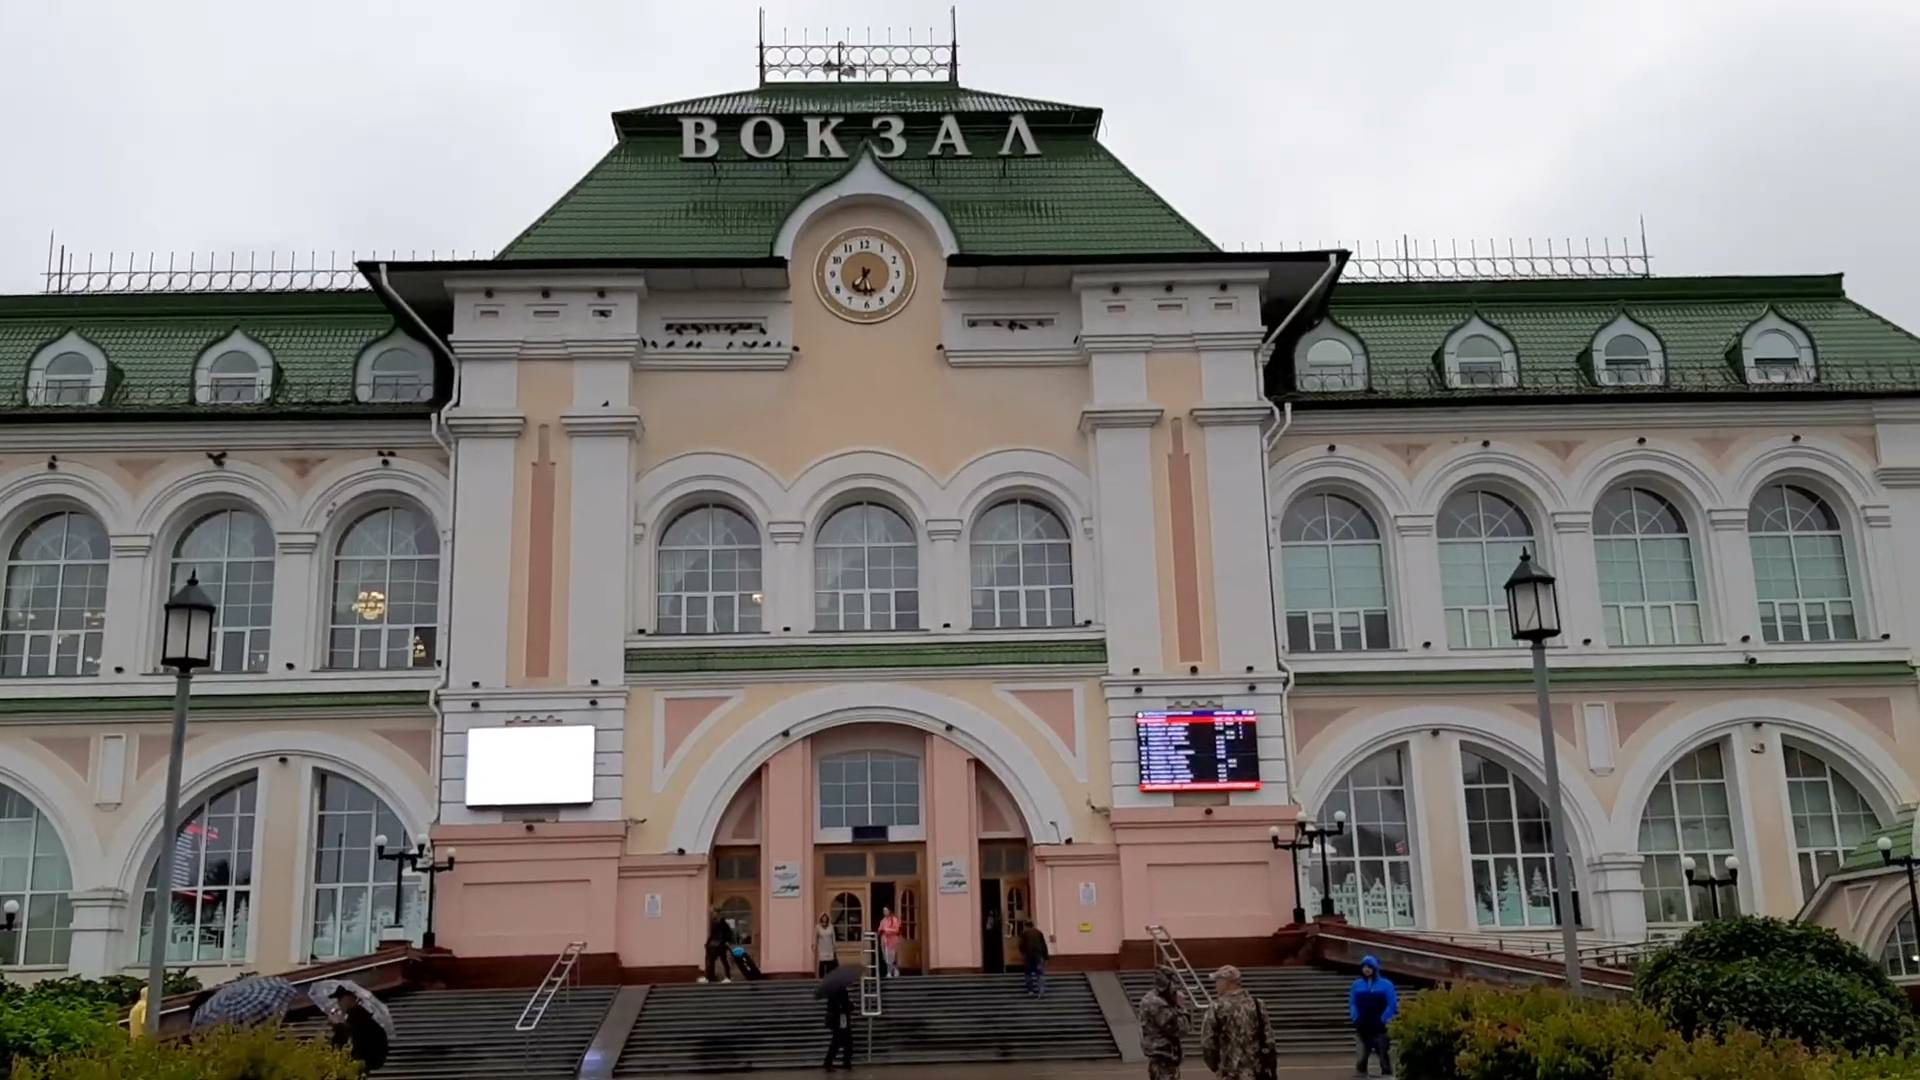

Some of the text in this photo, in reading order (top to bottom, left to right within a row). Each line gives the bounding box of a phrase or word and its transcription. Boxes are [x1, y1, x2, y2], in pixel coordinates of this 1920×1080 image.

[677, 114, 1042, 160] ВОКЗАЛ
[844, 243, 853, 253] 11
[860, 240, 870, 249] 12
[880, 243, 884, 253] 1
[833, 256, 842, 264] 10
[891, 256, 897, 264] 2
[830, 270, 836, 278] 9
[895, 270, 900, 279] 3
[835, 285, 841, 294] 8
[890, 285, 896, 294] 4
[847, 296, 853, 304] 7
[879, 296, 884, 305] 5
[864, 301, 870, 309] 6
